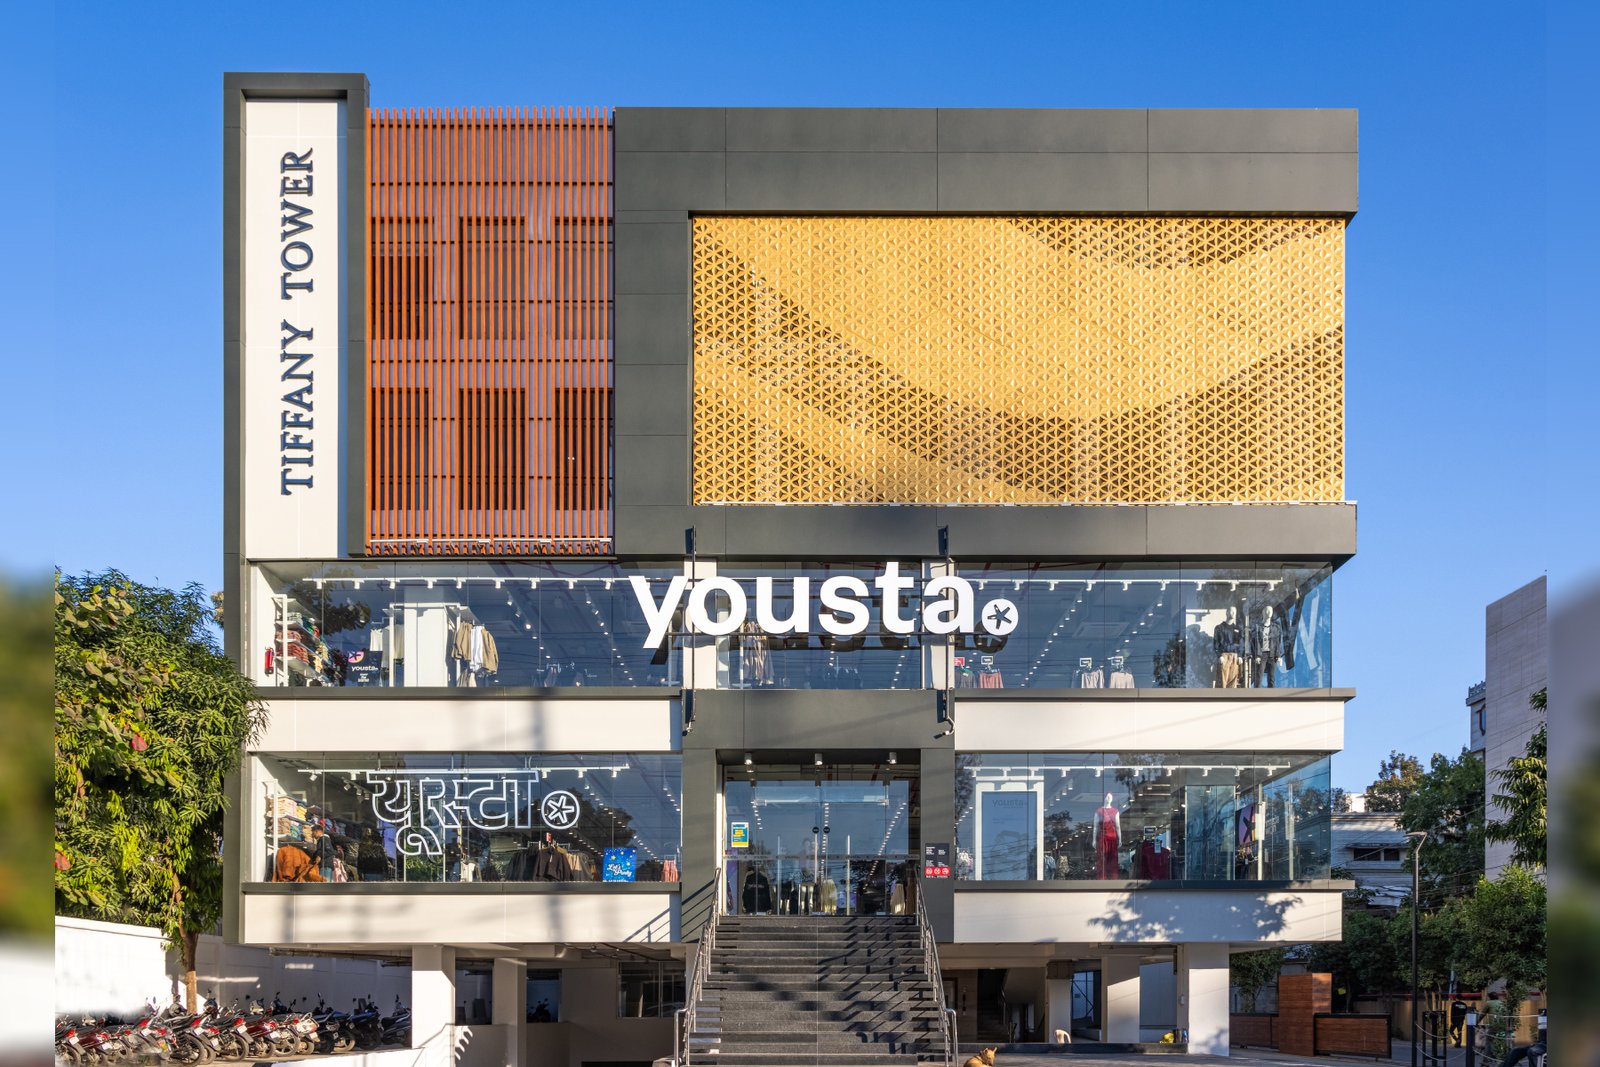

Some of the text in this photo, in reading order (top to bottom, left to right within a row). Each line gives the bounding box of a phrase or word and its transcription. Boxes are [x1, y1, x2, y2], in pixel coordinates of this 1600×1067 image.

[281, 148, 314, 496] TIFFANY TOWER
[629, 562, 974, 649] yousta
[366, 770, 539, 856] यूस्टा
